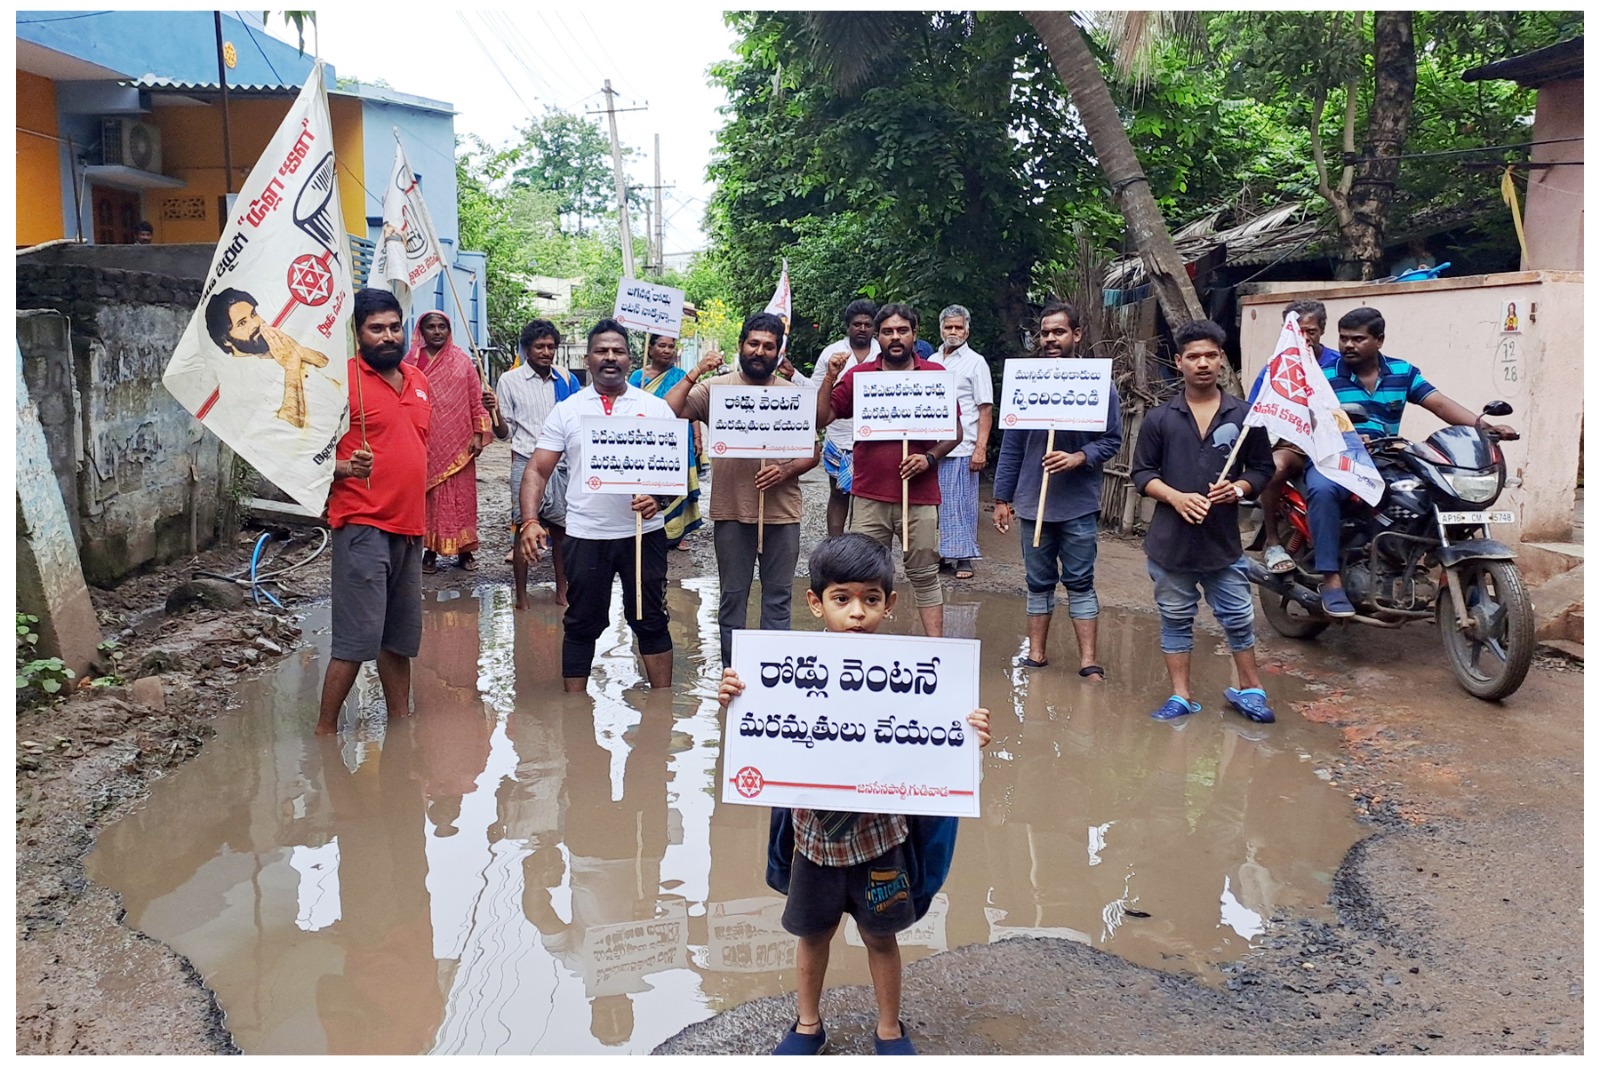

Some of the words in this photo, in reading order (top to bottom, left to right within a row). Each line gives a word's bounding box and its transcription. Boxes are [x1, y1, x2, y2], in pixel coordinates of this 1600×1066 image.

[1053, 370, 1101, 382] అధికారులు
[1504, 366, 1518, 382] 28
[925, 383, 946, 400] రోడ్లు
[1012, 389, 1100, 411] స్పందించండి
[725, 395, 755, 413] రోడ్లు
[759, 394, 801, 411] వెంటనే
[1252, 401, 1280, 416] పవన్
[862, 406, 911, 423] మరమ్మతులు
[914, 404, 949, 419] చేయండి
[715, 419, 770, 434] మరమ్మతులు
[773, 419, 810, 431] చేయండి
[658, 431, 678, 450] రోడ్లు
[590, 455, 645, 475] మరమ్మతులు
[647, 455, 681, 472] చేయండి
[1471, 514, 1483, 522] CM
[1493, 513, 1512, 521] 5748
[760, 655, 829, 699] రోడ్లు
[839, 656, 941, 695] వెంటనే
[739, 712, 867, 749] మరమ్మతులు
[873, 715, 965, 748] చేయండి
